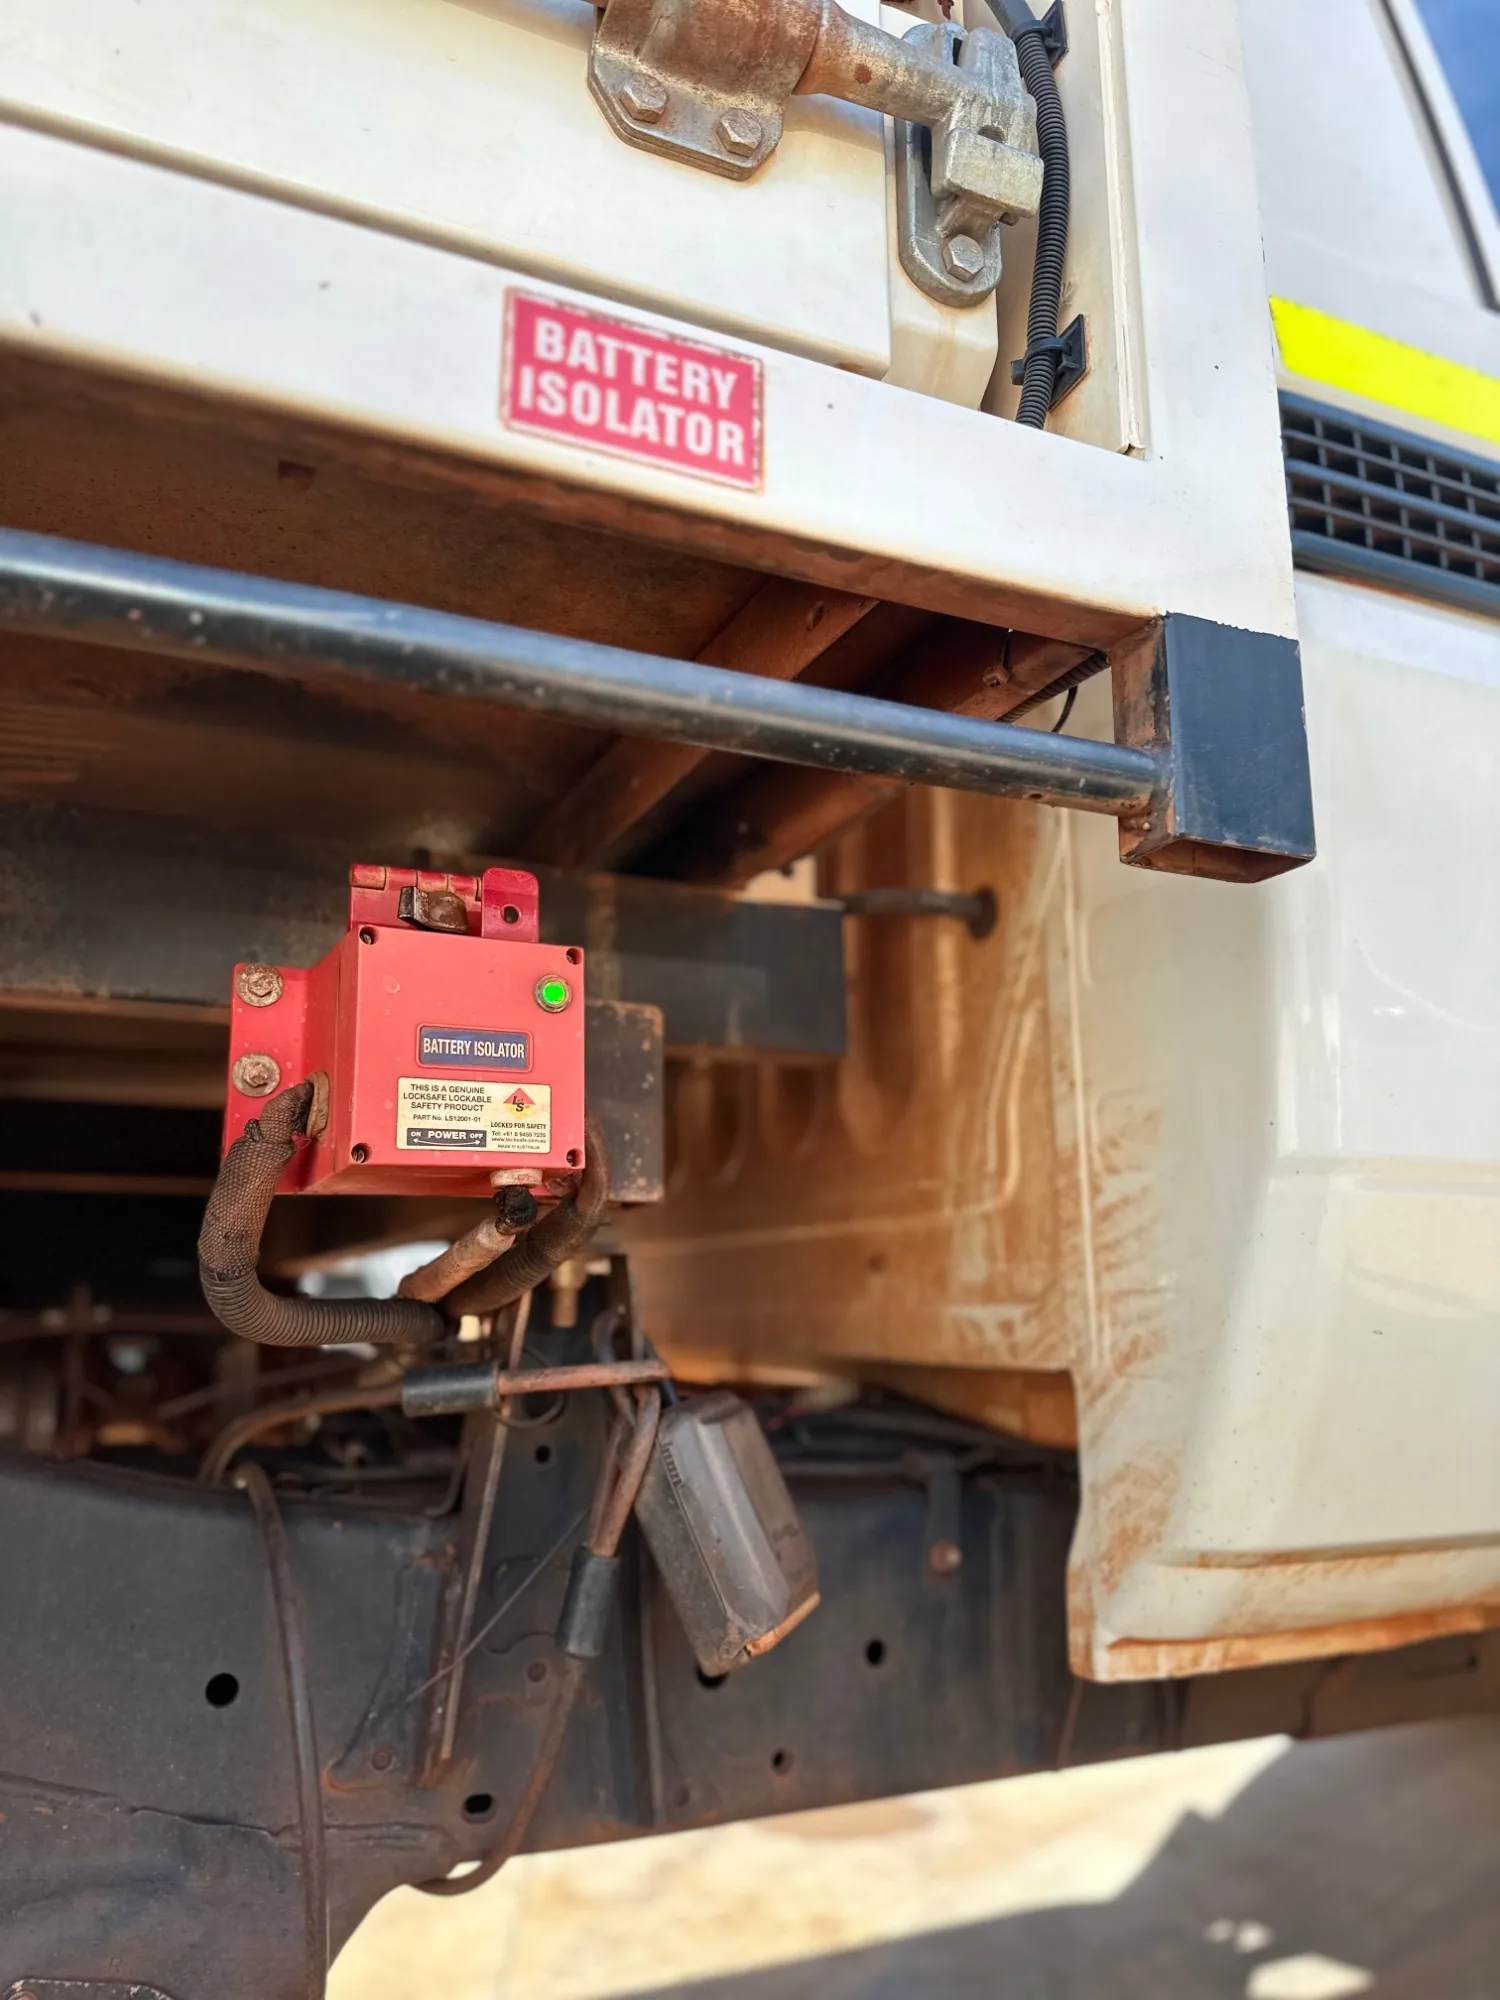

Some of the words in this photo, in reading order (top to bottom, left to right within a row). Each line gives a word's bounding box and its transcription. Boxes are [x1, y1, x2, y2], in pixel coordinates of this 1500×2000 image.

[534, 317, 737, 409] BATTERY
[519, 365, 745, 466] ISOLATOR
[423, 1038, 471, 1055] BATTERY
[474, 1041, 525, 1058] ISOLATOR
[411, 1084, 430, 1092] THIS
[449, 1086, 485, 1094] GENUINE
[403, 1092, 447, 1101] LOCKSAFE
[449, 1094, 492, 1103] LOCKABLE
[411, 1102, 443, 1110] SAFETY
[444, 1103, 484, 1111] PRODUCT
[427, 1130, 467, 1139] POWER
